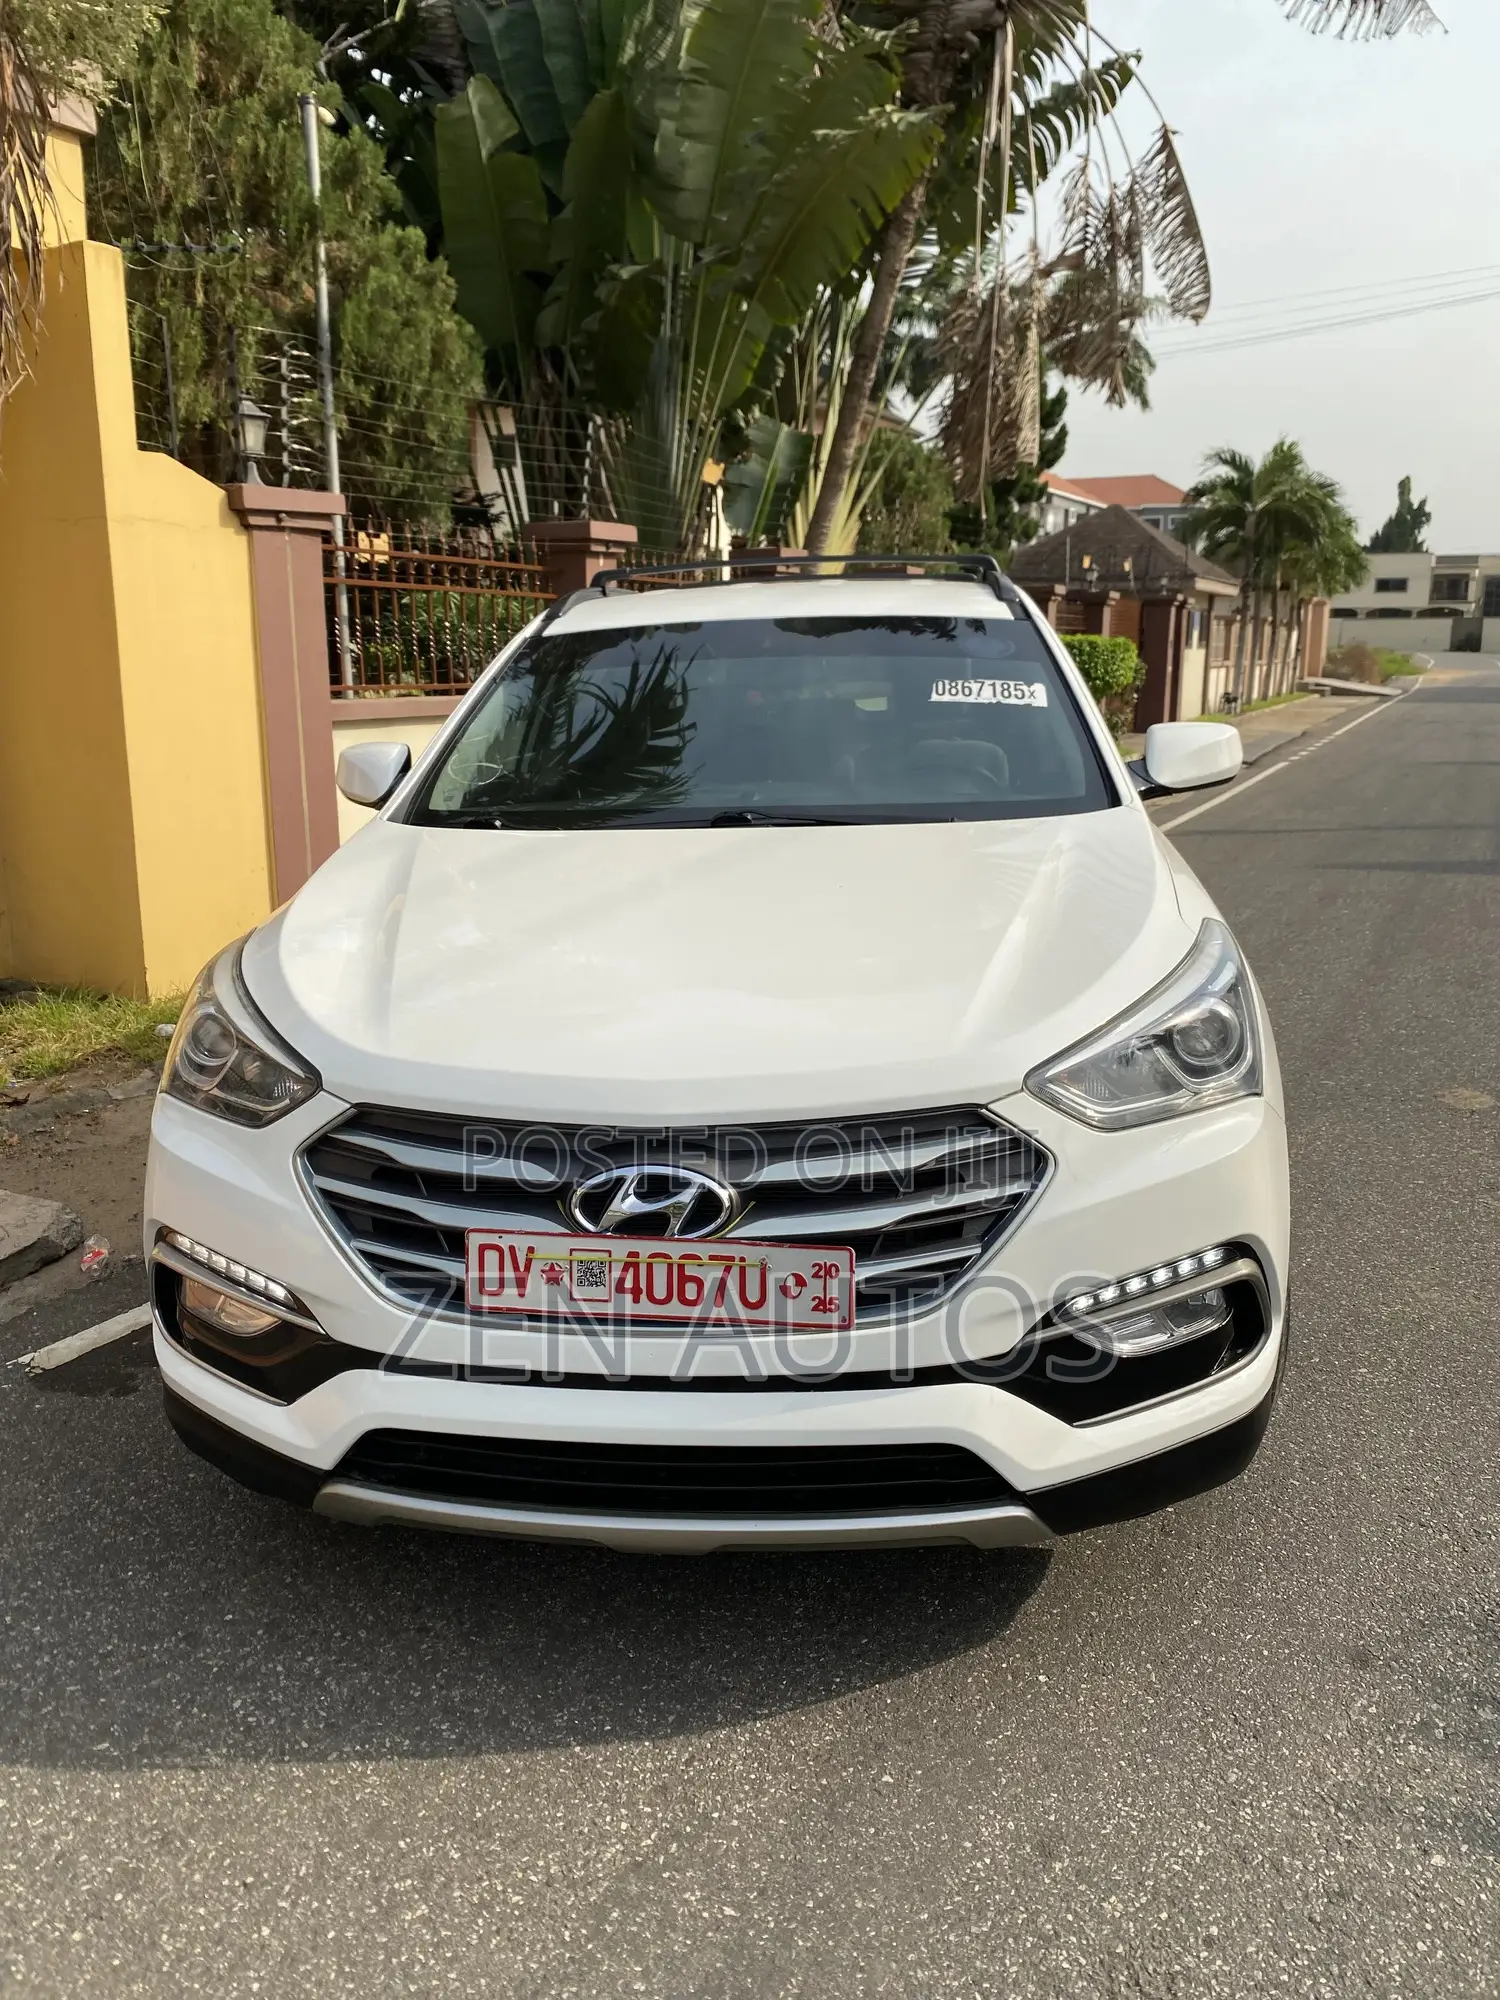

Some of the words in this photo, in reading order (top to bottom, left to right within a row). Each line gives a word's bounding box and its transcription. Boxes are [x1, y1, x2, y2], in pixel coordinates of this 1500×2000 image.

[478, 1243, 536, 1298] DV
[811, 1262, 840, 1280] 20
[811, 1295, 840, 1313] 25
